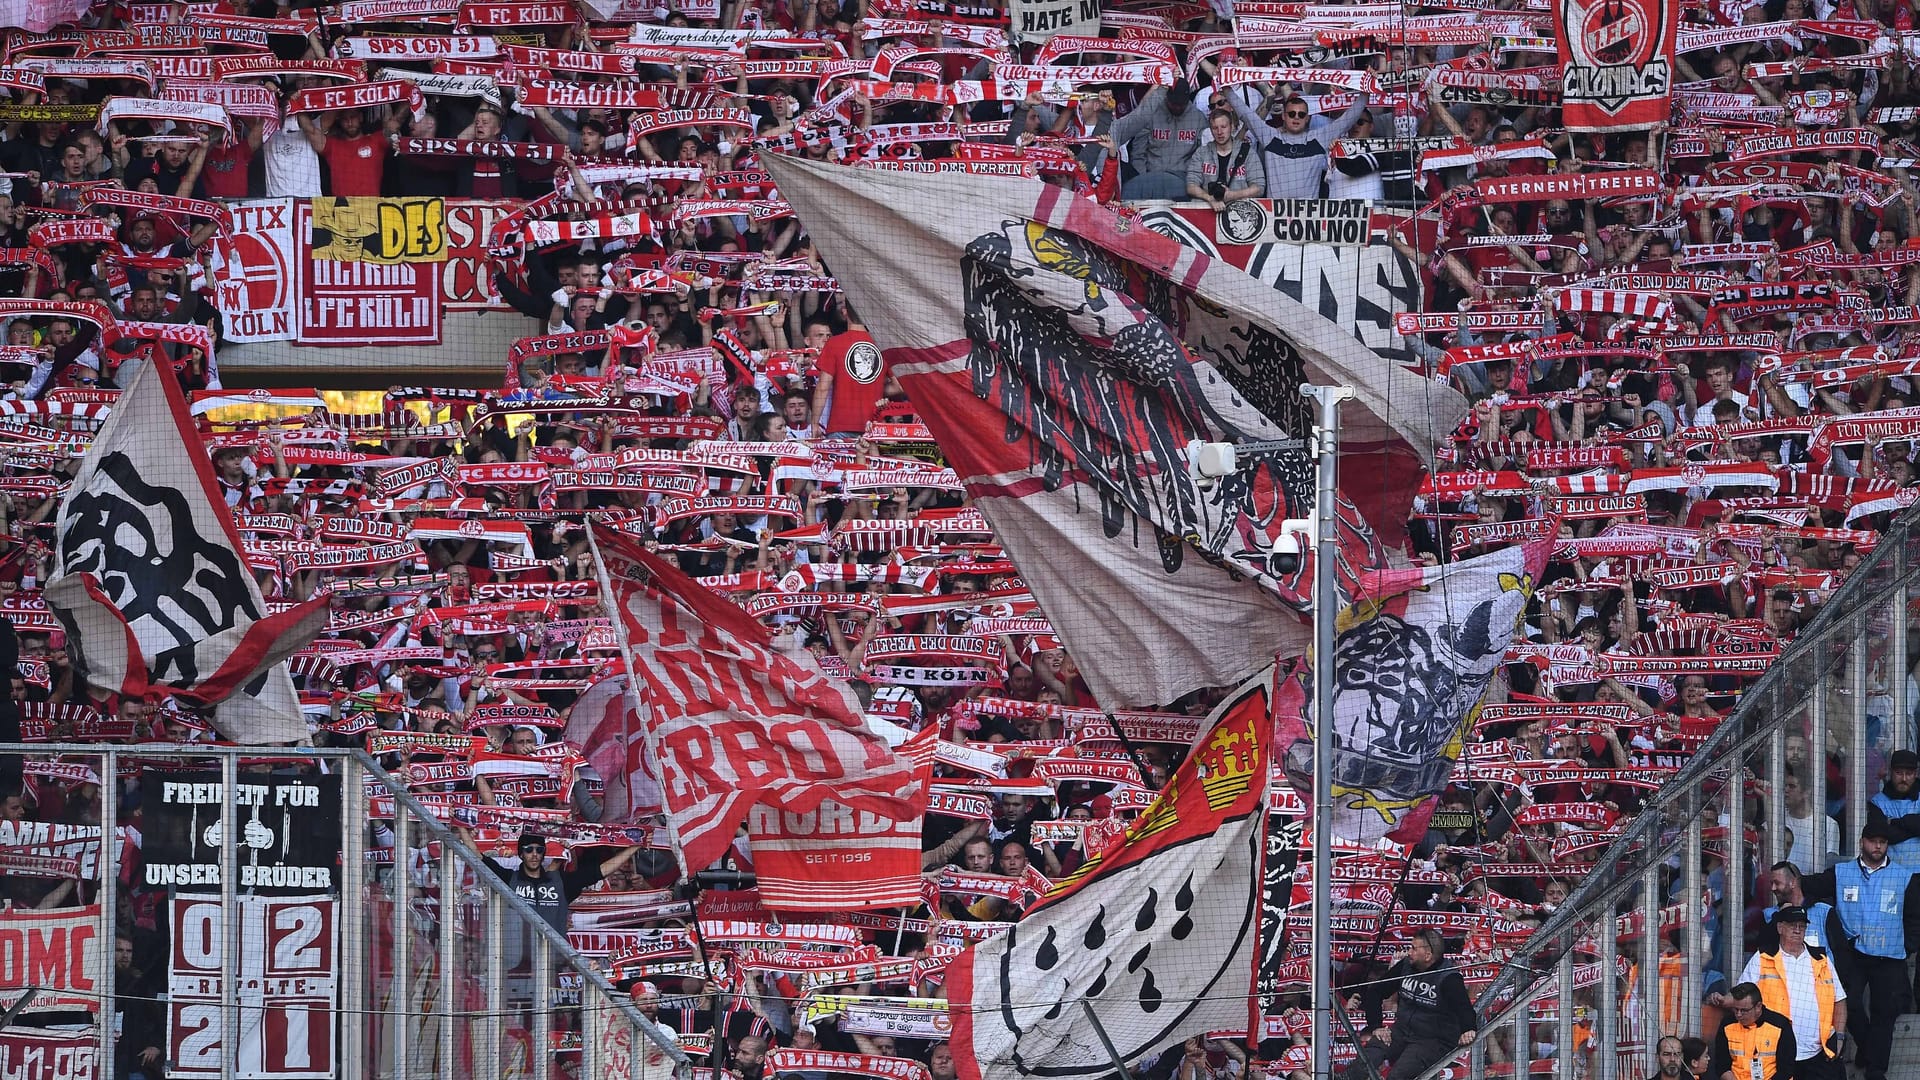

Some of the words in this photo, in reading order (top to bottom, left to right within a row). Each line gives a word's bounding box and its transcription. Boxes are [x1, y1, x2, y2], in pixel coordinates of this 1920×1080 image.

[490, 7, 510, 22] FC
[519, 6, 566, 22] KÖLN
[1022, 9, 1074, 32] HATE
[197, 24, 222, 40] DER
[368, 38, 410, 52] SPS
[416, 38, 452, 52] CGN
[460, 38, 480, 52] 51
[220, 59, 242, 72] FÜR
[244, 59, 284, 69] IMMER
[528, 50, 550, 64] FC
[558, 54, 602, 70] KÖLN
[746, 62, 781, 74] SIND
[786, 62, 812, 74] DIE
[1092, 66, 1133, 80] Köln
[1309, 70, 1351, 85] Köln
[304, 95, 317, 108] 1.
[325, 91, 345, 105] FC
[354, 84, 400, 104] KÖLN
[658, 110, 694, 124] SIND
[698, 109, 724, 122] DIE
[1796, 132, 1819, 146] DER
[1825, 132, 1855, 145] SIND
[410, 140, 457, 154] SPS
[466, 144, 518, 158] CGN
[527, 145, 552, 159] 51
[1745, 138, 1794, 154] VEREIN
[874, 162, 902, 172] WIR
[905, 162, 934, 173] SIND
[939, 163, 966, 174] DER
[971, 164, 1022, 175] VEREIN
[1710, 162, 1827, 180] KÖLN
[1478, 181, 1568, 198] LATERNEN
[1590, 176, 1656, 190] TRETER
[85, 192, 152, 205] UNSERE
[178, 201, 222, 217] LIEBE
[72, 224, 112, 237] KÖLN
[380, 199, 443, 257] DES
[1275, 220, 1321, 241] CON
[1328, 220, 1367, 242] NOI
[1633, 276, 1662, 290] SIND
[1666, 277, 1692, 288] DER
[1752, 286, 1788, 297] BIN
[1798, 284, 1827, 296] FC
[304, 298, 354, 328] 1.FC
[359, 296, 430, 328] KÖLN
[230, 312, 288, 337] KÖLN
[1491, 314, 1517, 326] DIE
[531, 338, 560, 350] FC
[1665, 335, 1695, 347] SIND
[1700, 335, 1724, 347] DER
[1728, 335, 1775, 348] VEREIN
[1482, 345, 1506, 356] FC
[1838, 425, 1860, 436] FÜR
[1863, 425, 1903, 435] IMMER
[624, 449, 750, 467] DOUBLESIEGER
[383, 470, 412, 490] SIND
[414, 462, 438, 477] DER
[460, 469, 483, 481] FC
[491, 464, 549, 478] KÖLN
[555, 473, 578, 486] WIR
[583, 473, 613, 485] SIND
[617, 474, 642, 486] DER
[647, 476, 696, 491] VEREIN
[1432, 476, 1450, 487] FC
[666, 501, 688, 514] WIR
[694, 498, 732, 507] SIND
[736, 497, 763, 507] DIE
[1600, 496, 1636, 509] SIND
[243, 516, 293, 528] VEREIN
[329, 518, 364, 532] SIND
[368, 520, 398, 532] DIE
[313, 550, 343, 563] SIND
[346, 549, 370, 561] DER
[372, 543, 415, 560] VEREIN
[1693, 568, 1720, 581] DIE
[1715, 641, 1772, 654] KÖLN
[1613, 660, 1638, 671] WIR
[1644, 659, 1677, 670] SIND
[1681, 659, 1708, 669] DER
[1713, 660, 1766, 671] VEREIN
[892, 668, 916, 678] FC
[924, 668, 987, 680] KÖLN
[1578, 705, 1630, 719] VEREIN
[429, 766, 452, 778] WIR
[1050, 764, 1094, 776] IMMER
[1098, 765, 1123, 777] 1.FC
[1546, 770, 1579, 780] SIND
[1583, 770, 1609, 779] DER
[163, 783, 268, 806] FREIEIT
[276, 780, 320, 806] FÜR
[944, 797, 985, 814] FANS
[806, 852, 838, 864] SEIT
[841, 853, 871, 863] 1996
[242, 862, 332, 888] BRÜDER
[274, 906, 323, 968] 2
[178, 1004, 223, 1069] 2
[284, 1004, 310, 1068] 1
